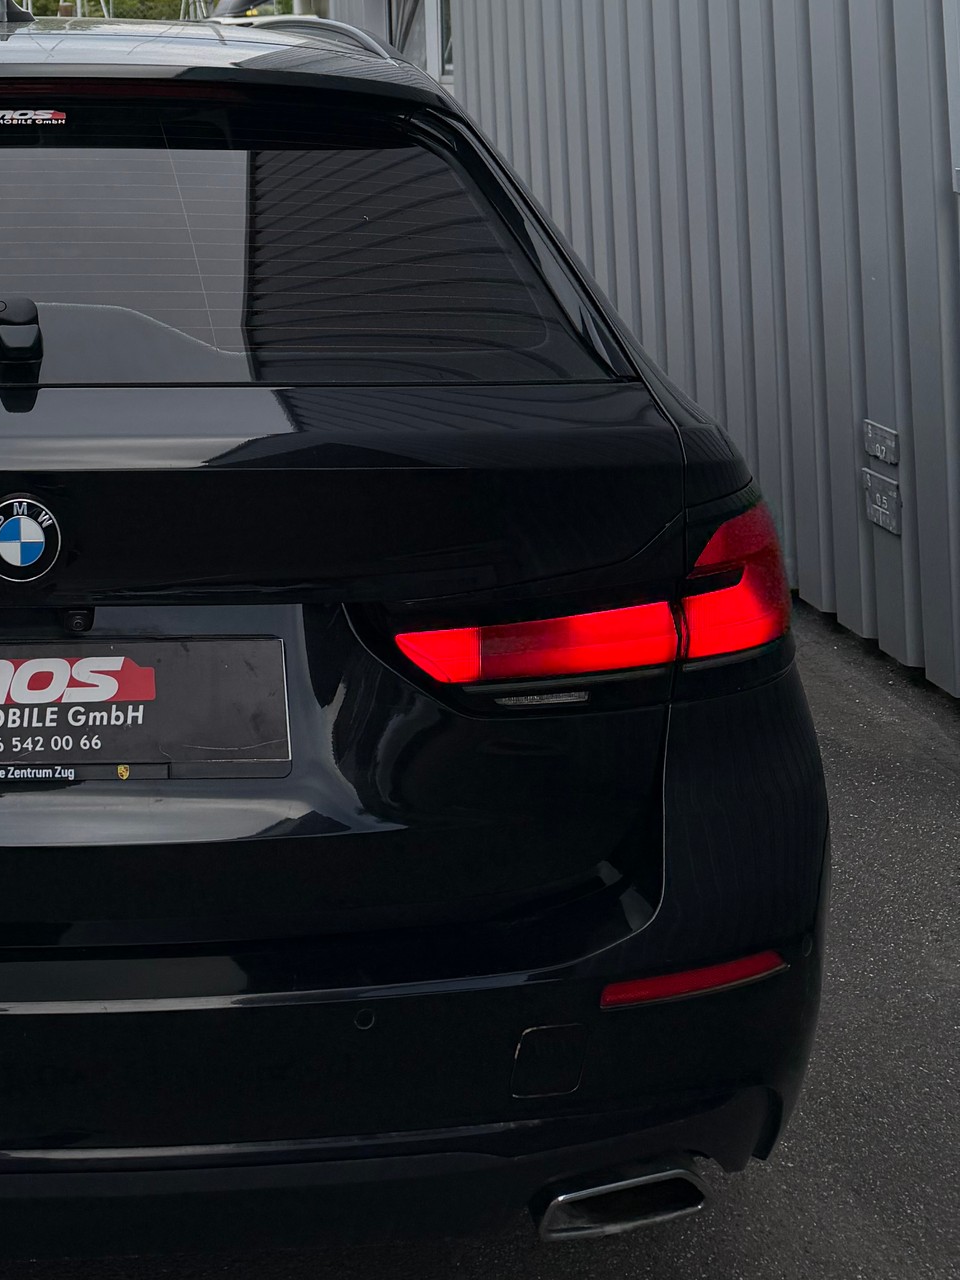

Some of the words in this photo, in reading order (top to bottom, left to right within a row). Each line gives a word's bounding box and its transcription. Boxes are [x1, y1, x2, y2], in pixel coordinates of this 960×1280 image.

[67, 704, 145, 726] GmbH
[11, 736, 45, 752] 542
[50, 735, 74, 751] 00
[79, 734, 103, 750] 66
[7, 767, 53, 779] Zentrum
[54, 766, 75, 780] Zug
